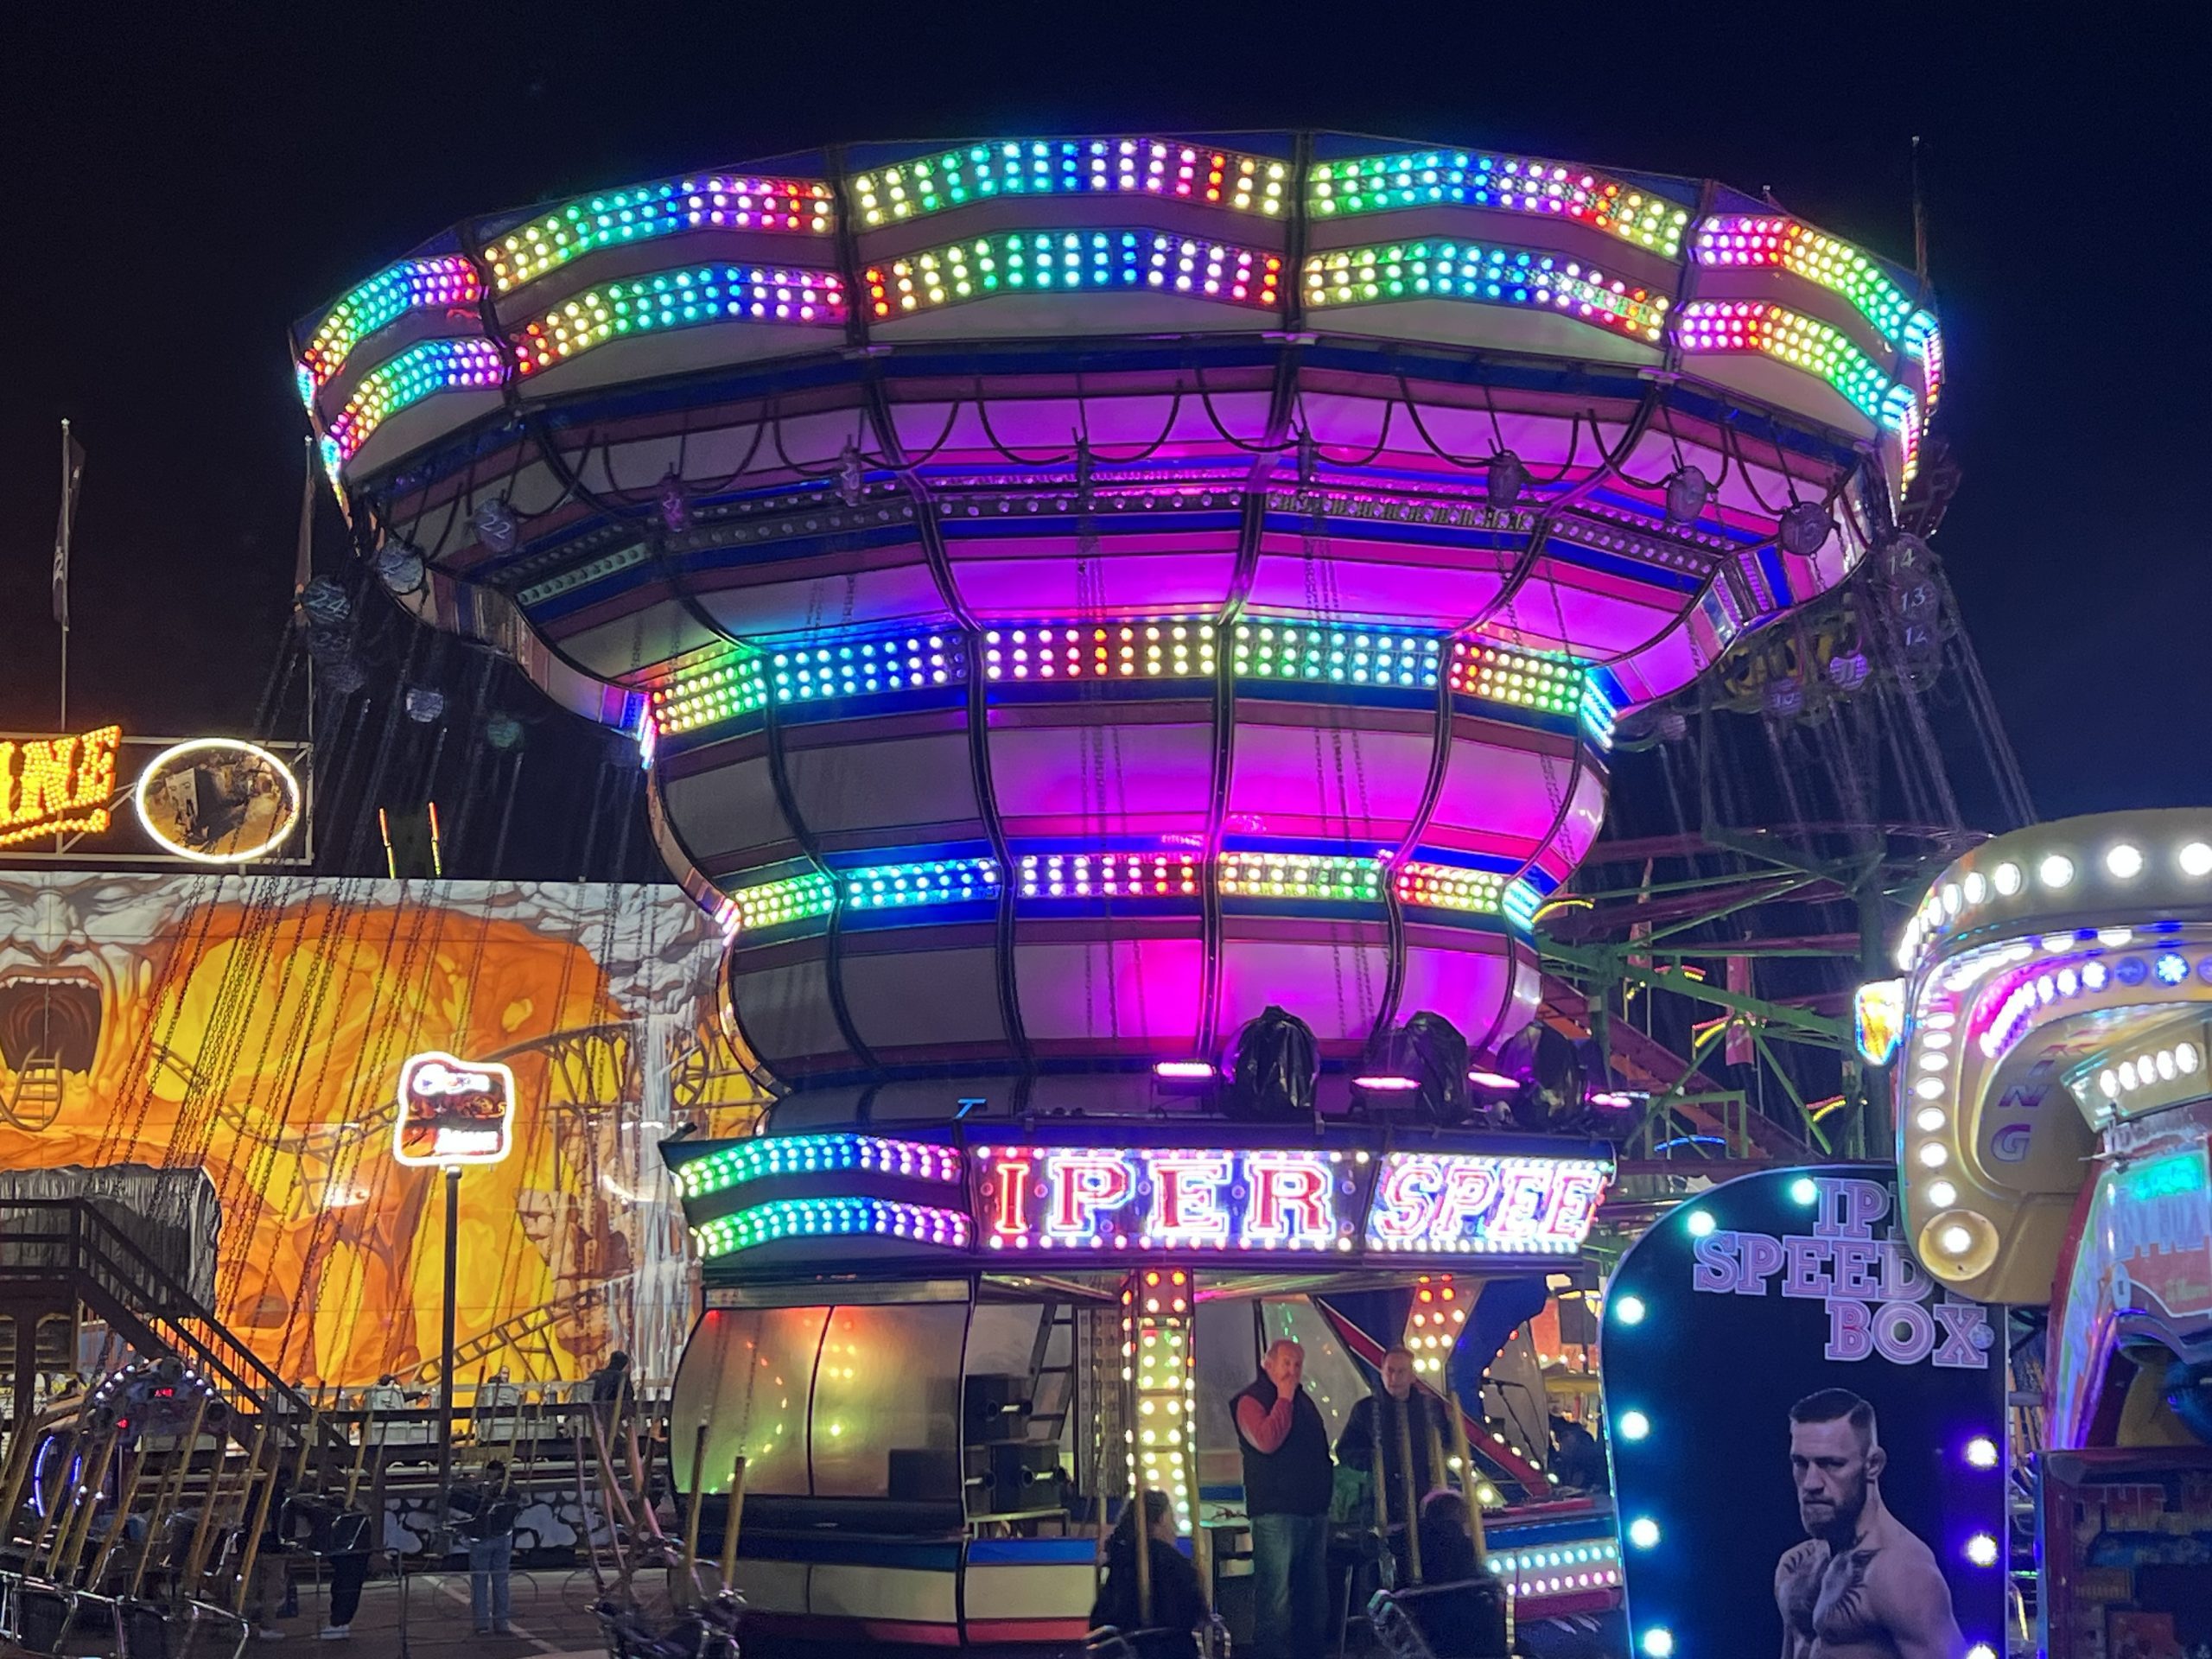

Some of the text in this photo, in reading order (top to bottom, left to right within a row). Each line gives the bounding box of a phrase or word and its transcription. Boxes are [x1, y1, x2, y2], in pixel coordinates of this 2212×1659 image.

[480, 513, 512, 540] 22
[1889, 548, 1916, 576] 14
[1901, 587, 1926, 612] 13
[996, 1158, 1336, 1238] IPER
[1813, 1177, 1906, 1241] IP
[1693, 1230, 1977, 1306] SPEED
[1824, 1298, 1988, 1369] BOX
